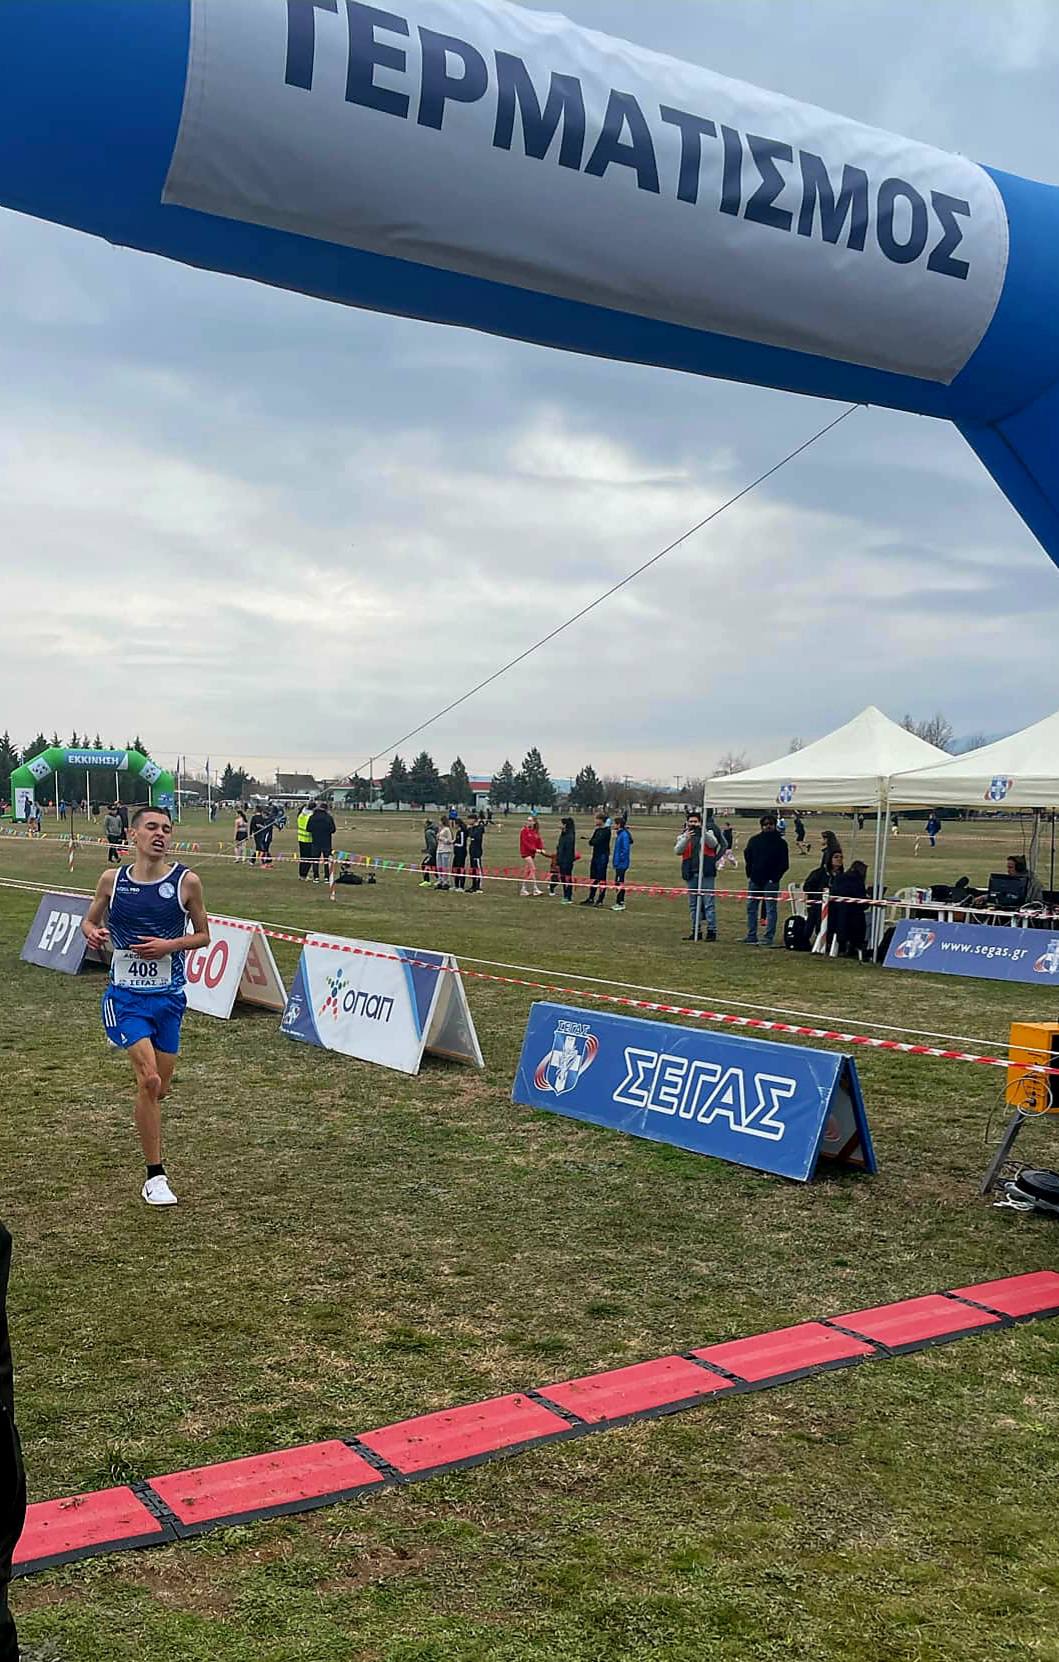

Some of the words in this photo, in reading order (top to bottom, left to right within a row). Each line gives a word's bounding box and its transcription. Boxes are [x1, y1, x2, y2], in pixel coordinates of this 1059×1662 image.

[68, 755, 119, 765] ΕΚΚΙΝΗΣΗ
[38, 910, 82, 954] ΕΡΤ
[941, 940, 1029, 961] www.segas.gr
[128, 961, 158, 977] 408
[185, 939, 229, 989] GO
[557, 1019, 591, 1035] ΣΕΓΑΣ
[612, 1046, 797, 1141] ΣΕΓΑΣ
